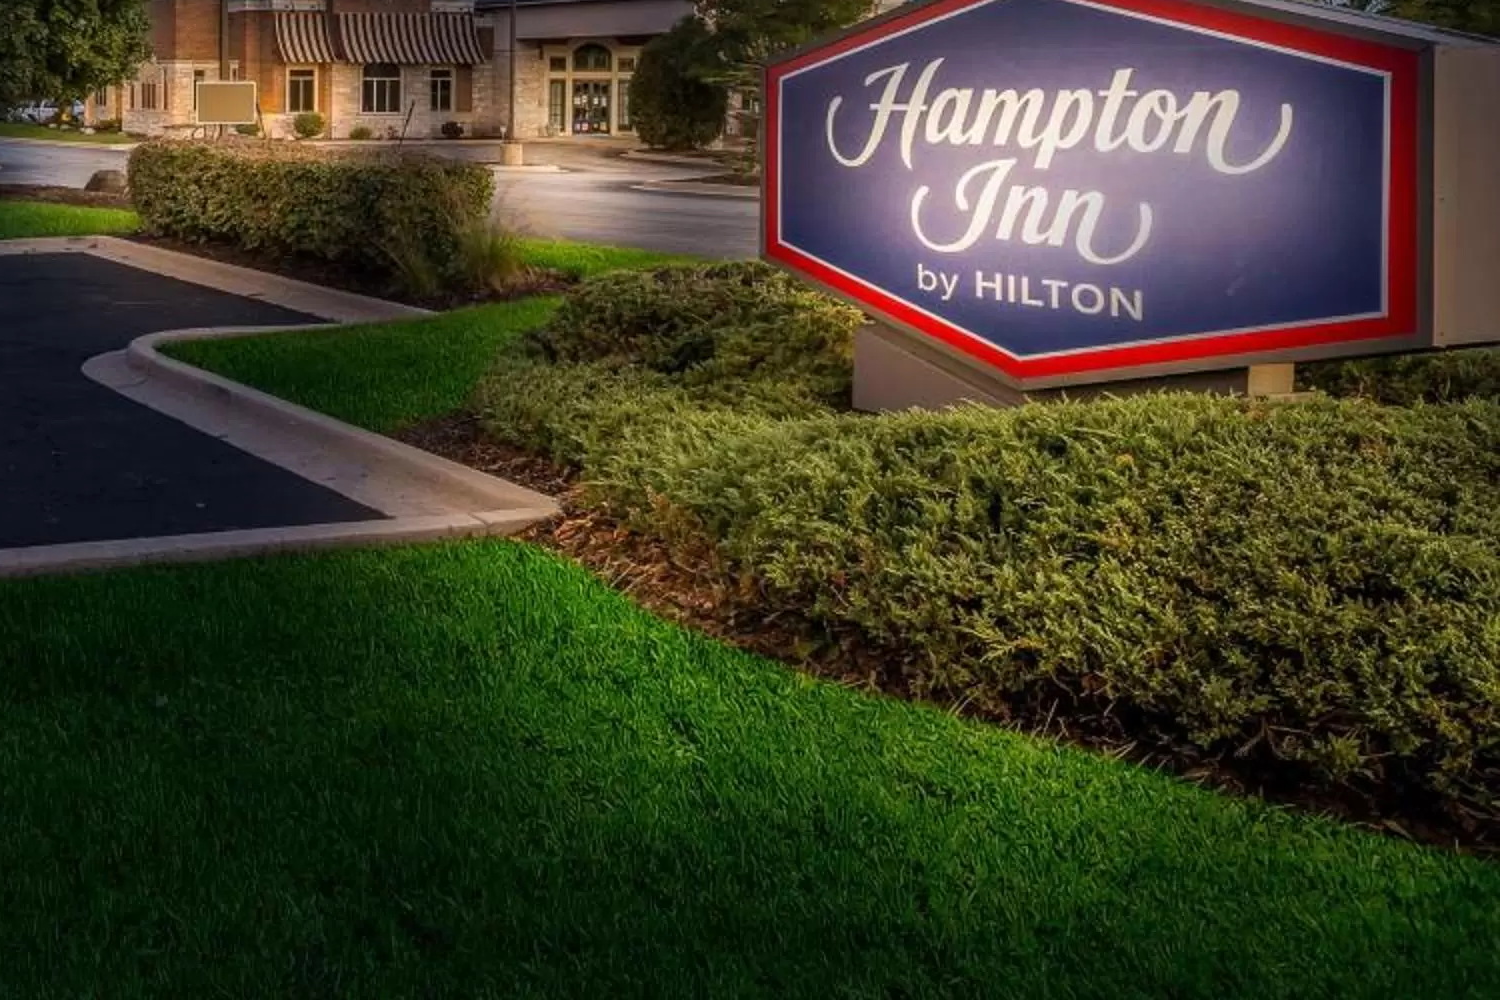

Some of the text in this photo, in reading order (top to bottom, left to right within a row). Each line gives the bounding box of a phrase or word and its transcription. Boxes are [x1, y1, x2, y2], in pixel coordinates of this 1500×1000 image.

[826, 56, 1294, 175] Hampton
[910, 157, 1153, 266] Inn
[916, 262, 1145, 322] by HILTON
